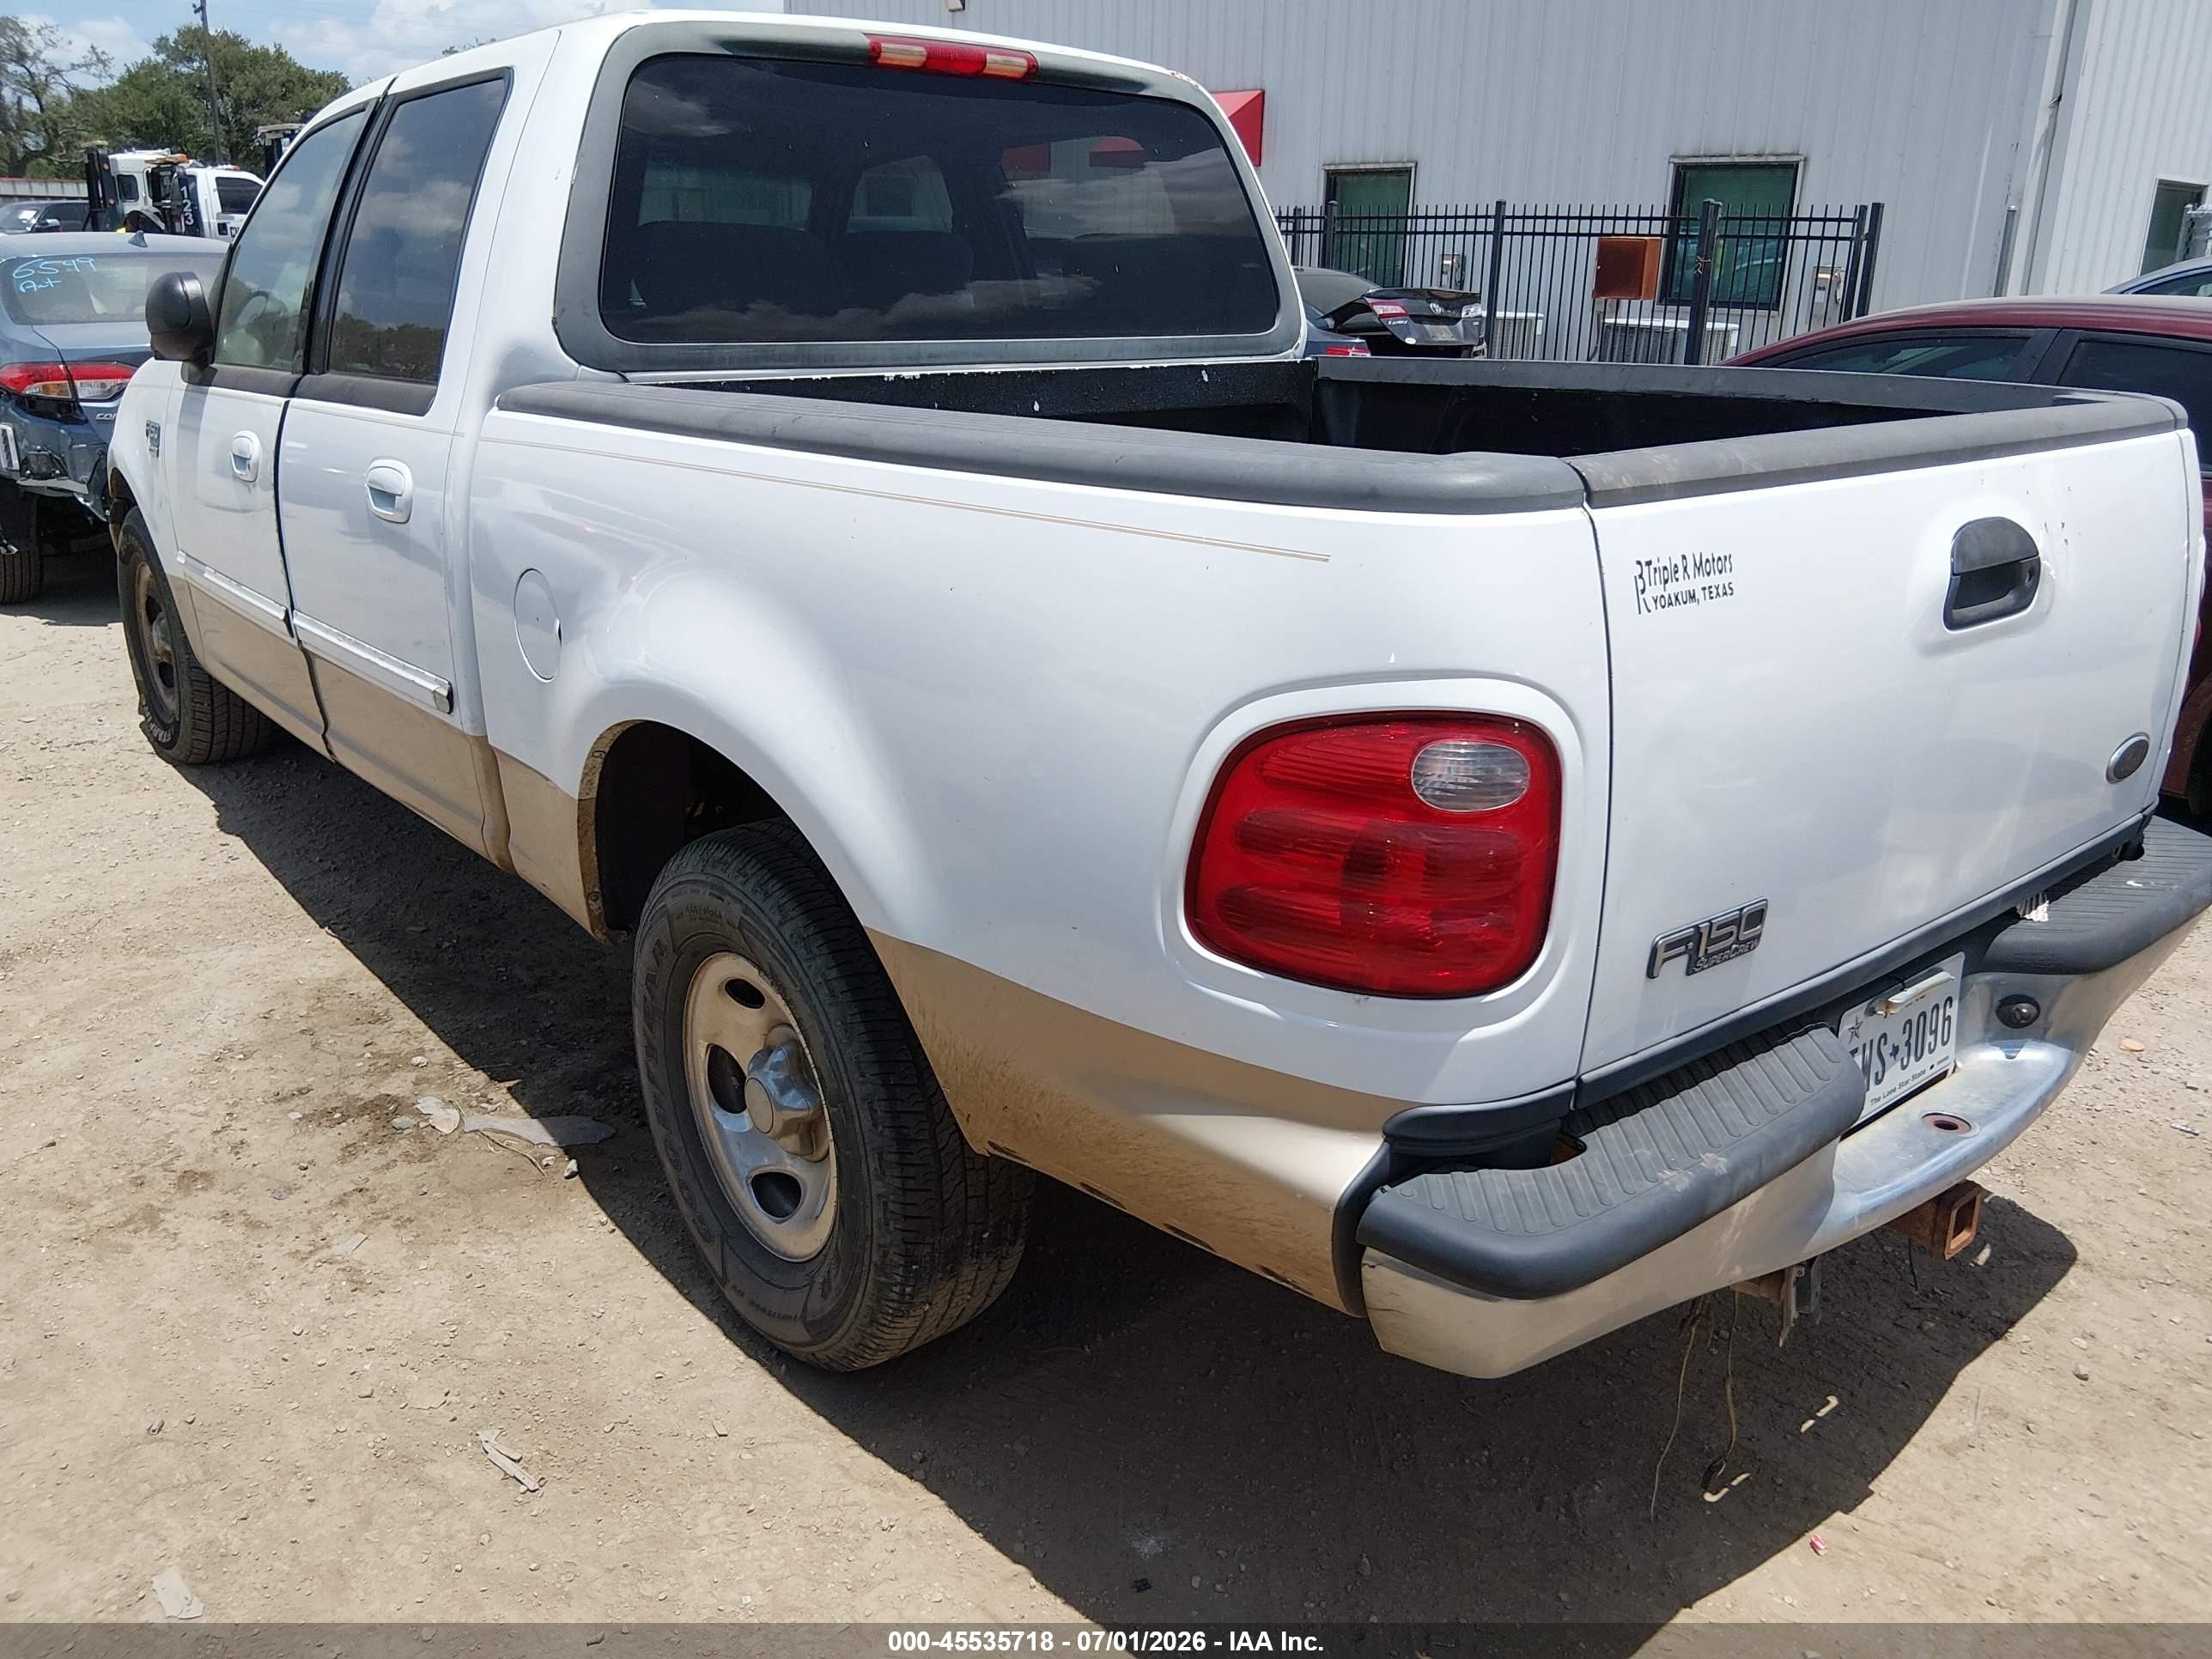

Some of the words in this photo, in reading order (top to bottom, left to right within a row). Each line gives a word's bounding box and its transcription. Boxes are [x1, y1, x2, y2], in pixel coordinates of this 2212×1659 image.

[1644, 556, 1680, 592] Triple
[1680, 554, 1691, 581] R
[1692, 551, 1733, 580] Motors
[1651, 588, 1700, 611] YOAKUM,
[1701, 581, 1735, 602] TEXAS
[1900, 995, 1954, 1072] 3096
[1898, 1078, 1910, 1090] Star
[1911, 1069, 1926, 1081] State
